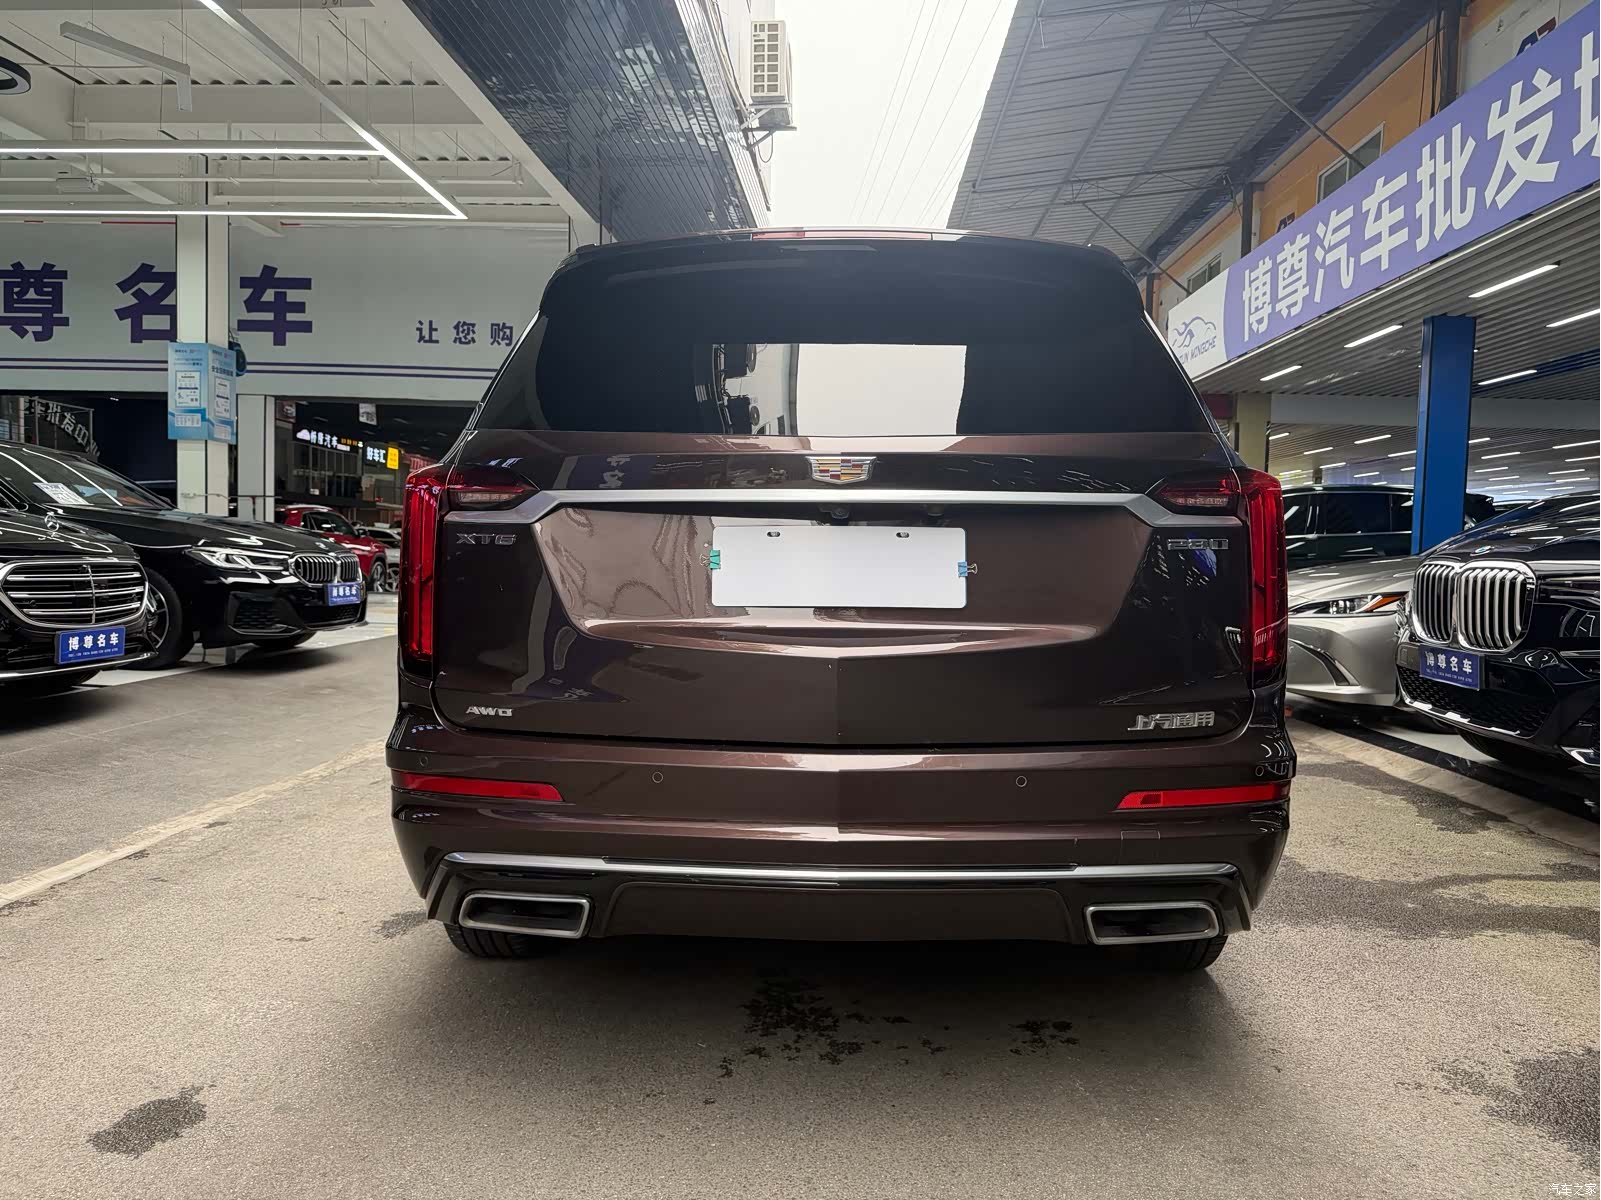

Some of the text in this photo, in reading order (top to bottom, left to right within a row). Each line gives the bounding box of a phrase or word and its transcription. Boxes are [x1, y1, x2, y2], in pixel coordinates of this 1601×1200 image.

[0, 261, 312, 346] 尊名车
[416, 319, 514, 347] 让您购
[366, 446, 386, 464] 好车汇
[456, 533, 516, 546] XT6
[68, 631, 119, 652] 博尊名车
[465, 706, 513, 717] AWD
[1127, 711, 1215, 730] 上汽通用
